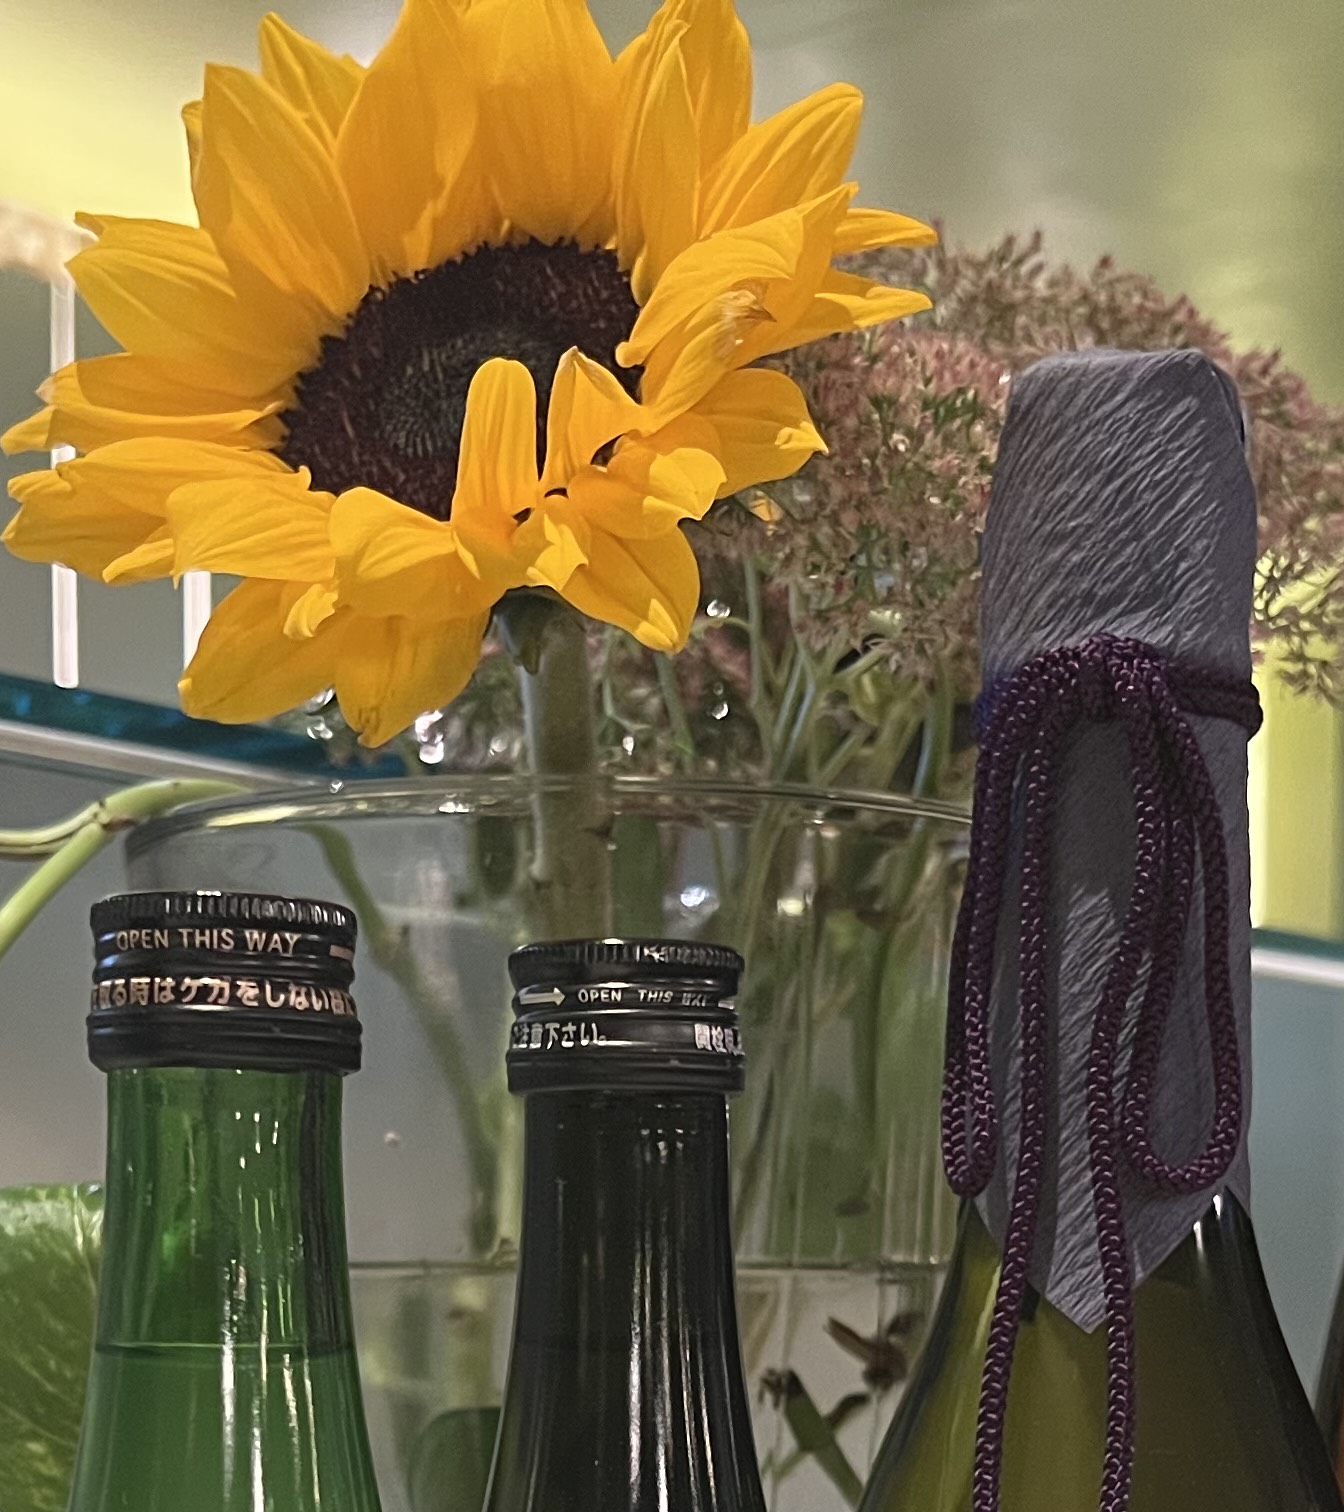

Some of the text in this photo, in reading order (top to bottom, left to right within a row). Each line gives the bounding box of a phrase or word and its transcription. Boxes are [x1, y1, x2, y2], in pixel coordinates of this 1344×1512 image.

[117, 928, 302, 957] OPEN THIS WAY
[578, 989, 622, 1003] OPEN
[638, 989, 674, 1004] THIS
